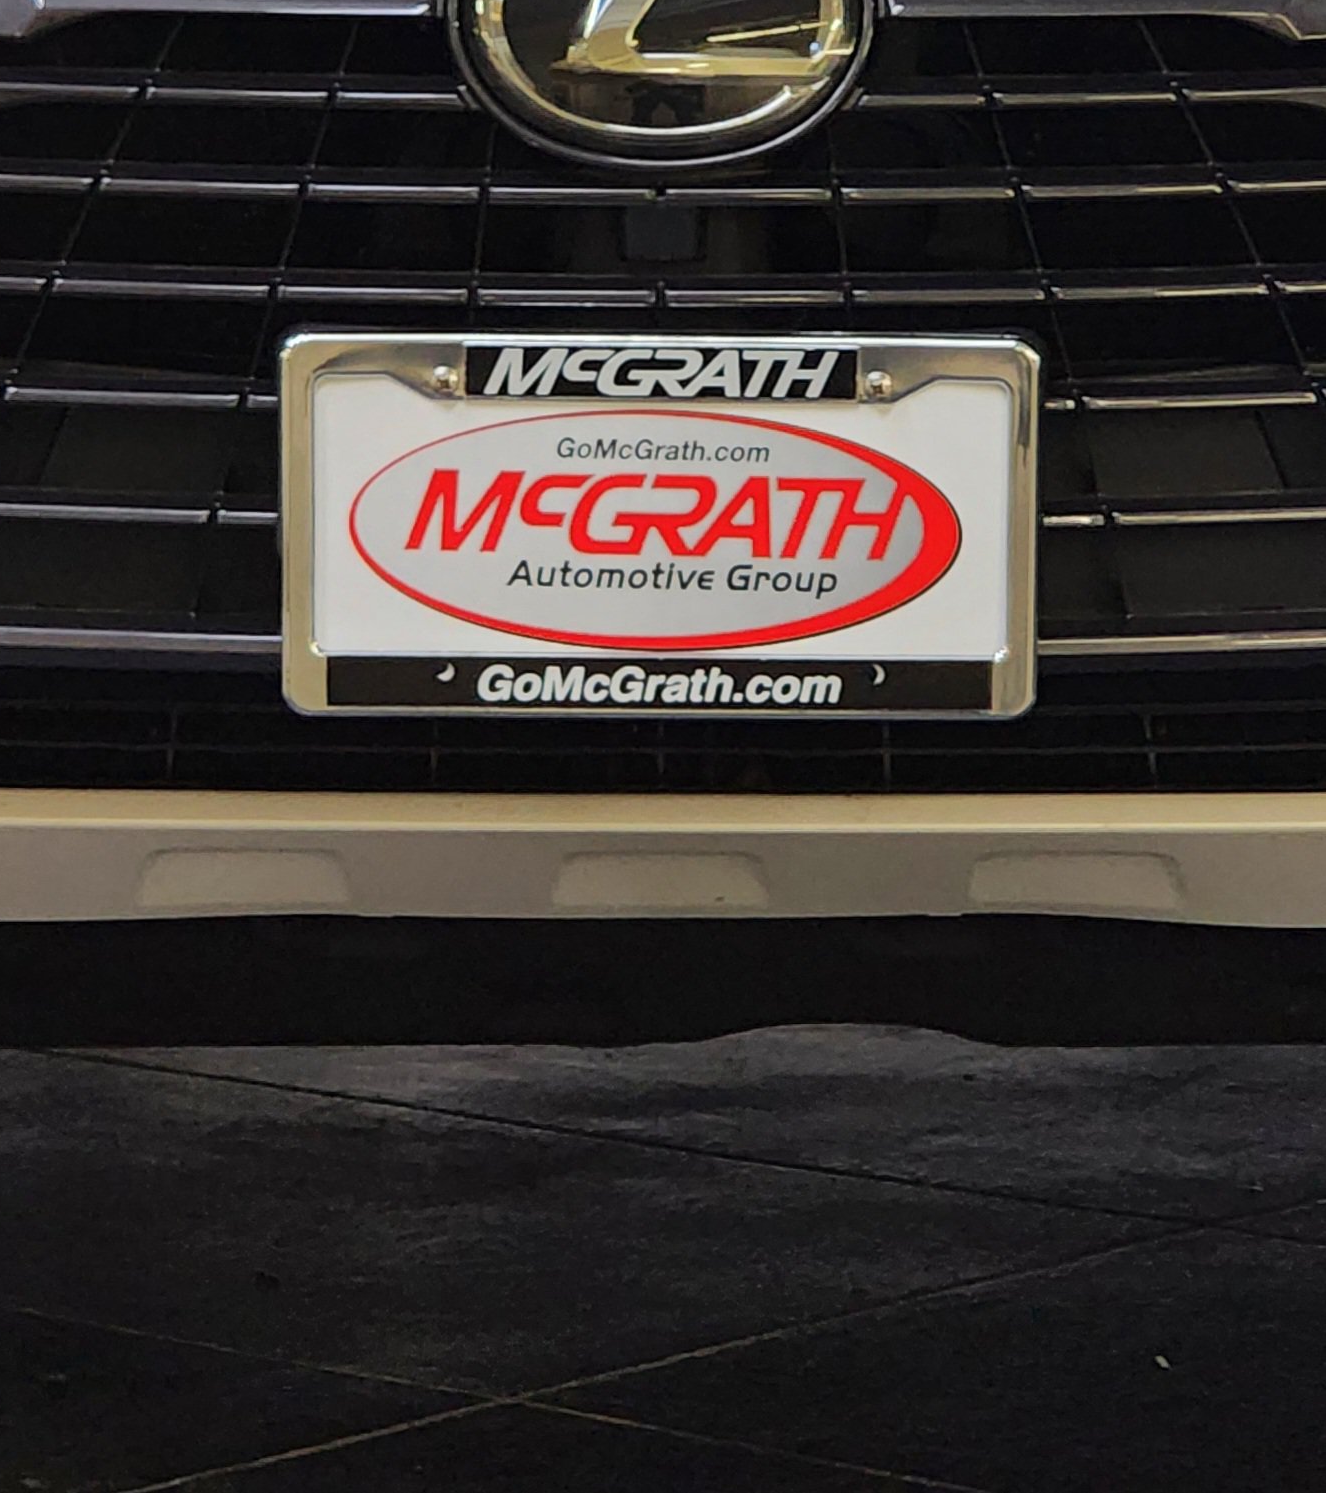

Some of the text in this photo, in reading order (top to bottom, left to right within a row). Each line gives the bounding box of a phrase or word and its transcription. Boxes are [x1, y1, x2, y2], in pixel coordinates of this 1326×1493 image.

[556, 437, 770, 463] GoMcGrath.com
[507, 561, 838, 599] Automotive Group
[477, 665, 842, 705] GoMcGrath.com
